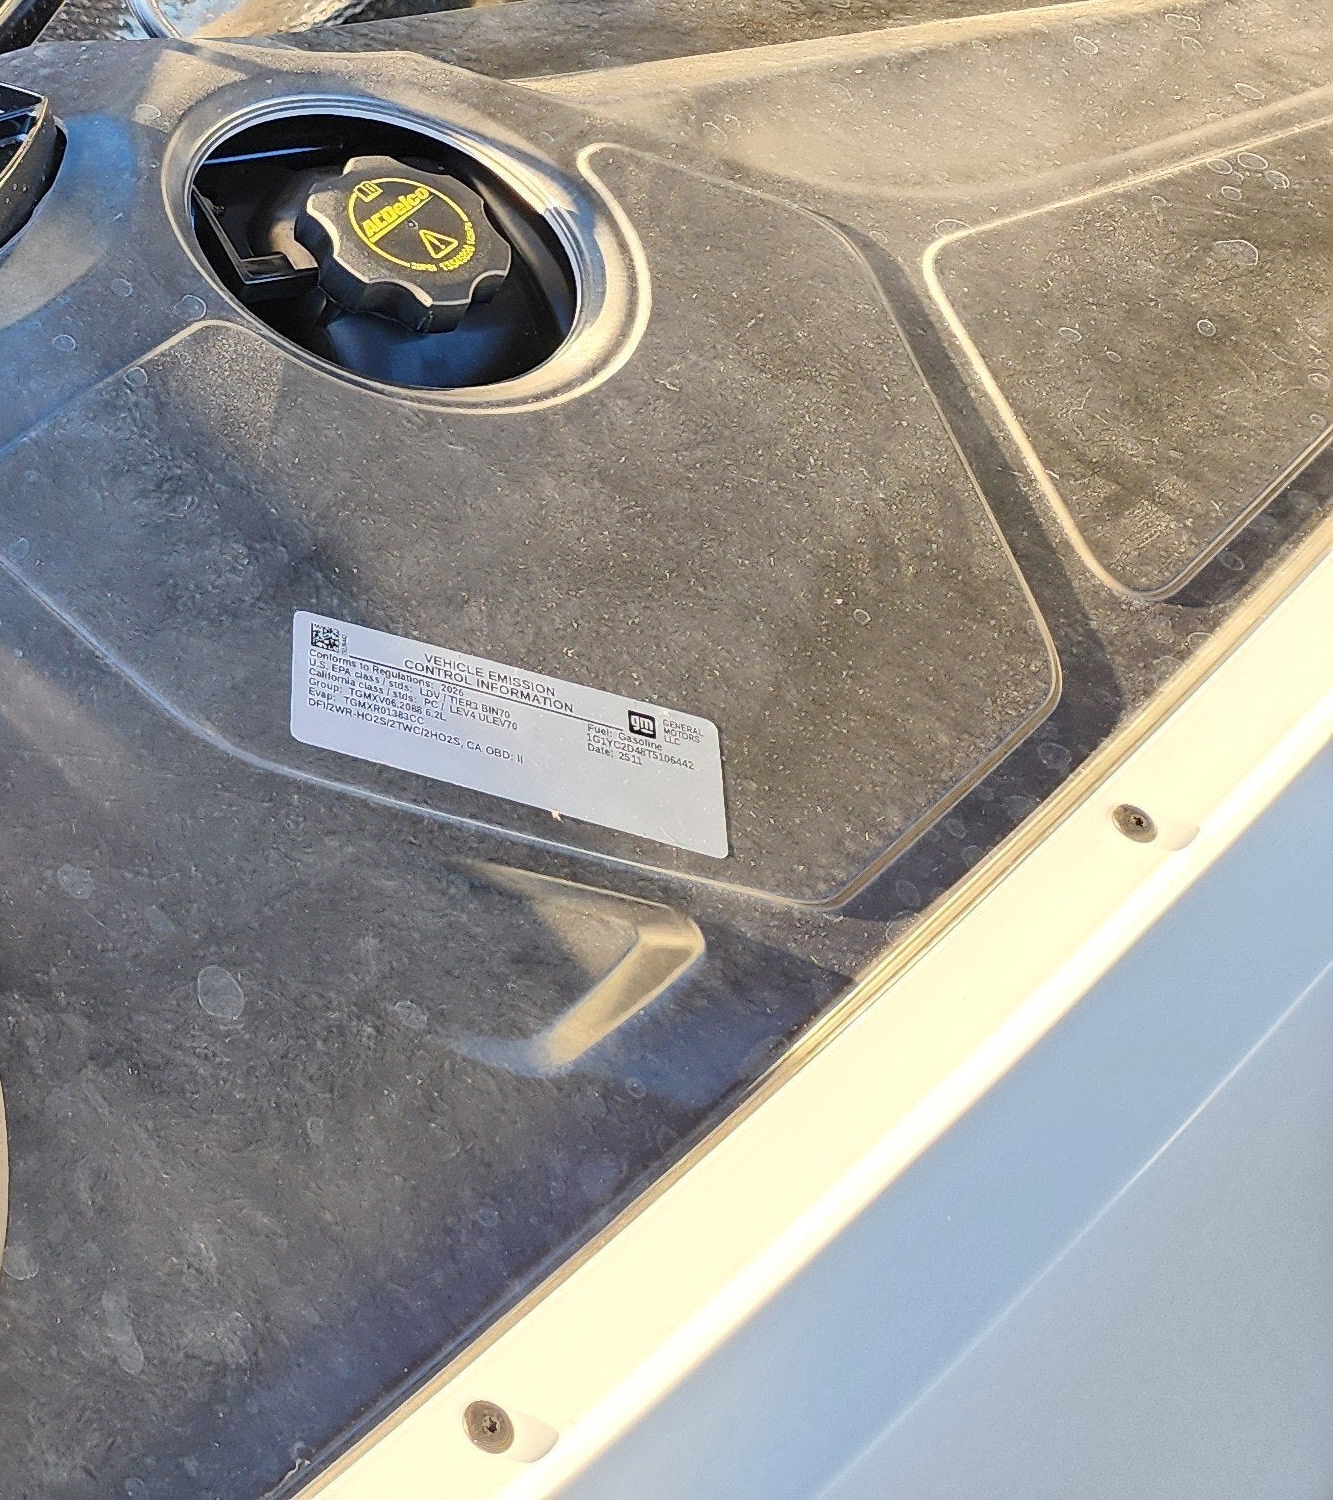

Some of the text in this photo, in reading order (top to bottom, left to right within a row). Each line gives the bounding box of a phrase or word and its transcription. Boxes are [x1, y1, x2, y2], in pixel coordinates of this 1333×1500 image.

[362, 187, 430, 238] ACDelco
[309, 648, 464, 697] Conforms to Regulations: 2026
[404, 659, 574, 713] CONTROL INFORMATION
[424, 653, 556, 697] VEHICLE EMISSION
[309, 657, 329, 671] U.S.
[331, 663, 351, 676] EPA
[354, 671, 380, 684] class
[388, 679, 413, 693] stds:
[419, 687, 440, 700] LDV
[481, 703, 511, 719] BIN70
[309, 686, 336, 702] Evap:
[309, 667, 356, 688] California
[358, 681, 384, 695] class
[393, 690, 417, 704] stds:
[424, 697, 439, 709] PC
[450, 704, 476, 720] LEV4
[478, 712, 518, 731] ULEV70
[309, 677, 343, 694] Group:
[425, 707, 447, 721] 6.2L
[587, 723, 663, 751] Fuel: Gasoline
[631, 713, 654, 735] gm
[662, 718, 704, 737] GENERAL
[663, 727, 700, 744] MOTORS
[466, 740, 482, 753] CA
[485, 746, 514, 762] OBD:
[587, 742, 643, 766] Date: 2511
[663, 735, 681, 746] LLC
